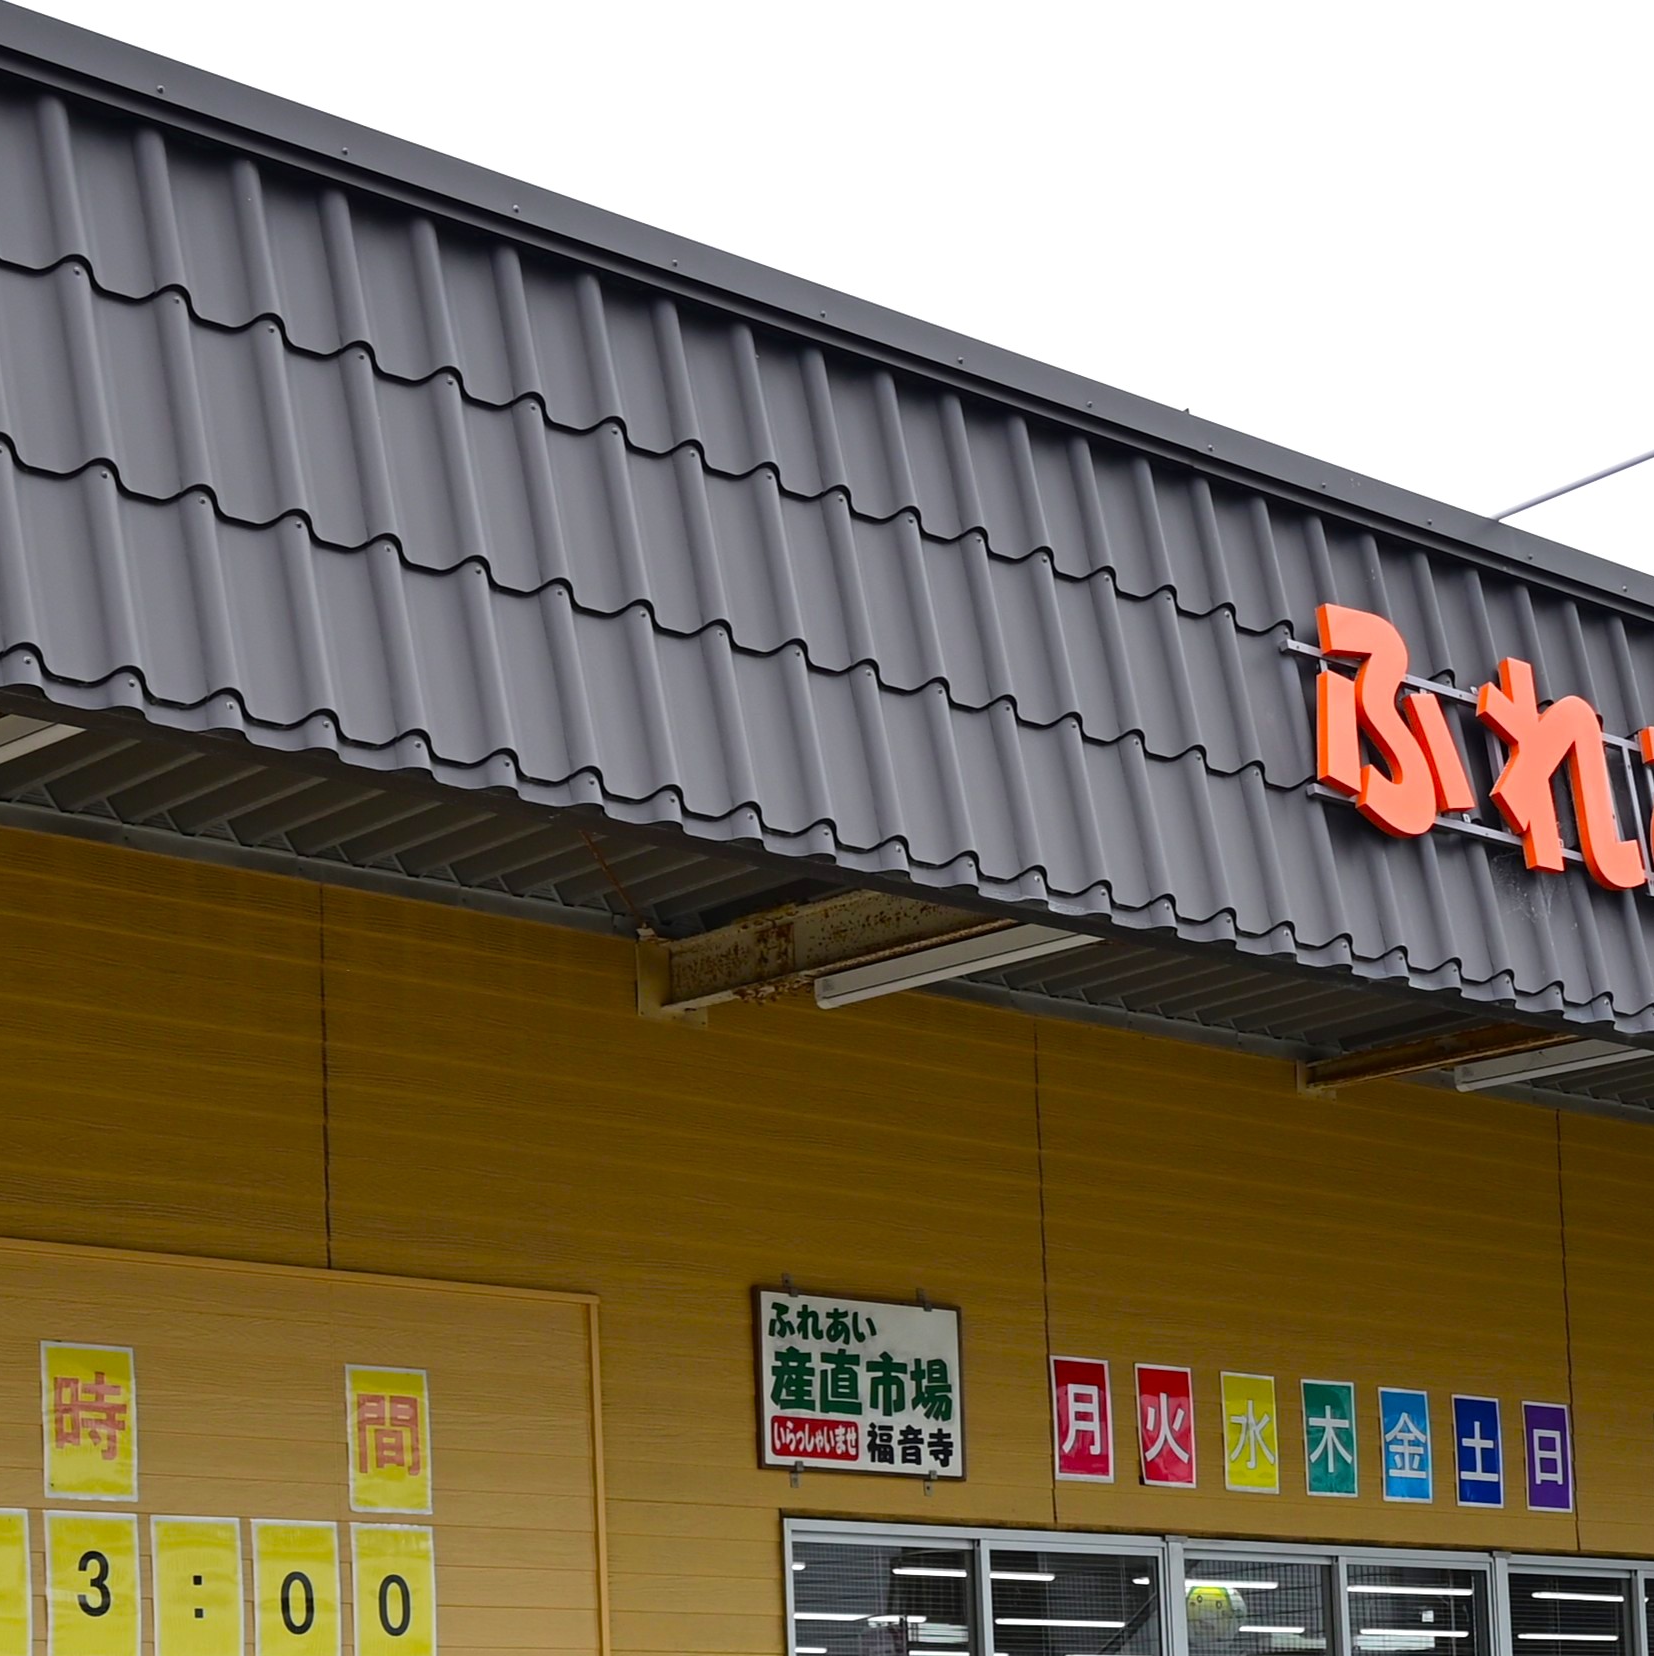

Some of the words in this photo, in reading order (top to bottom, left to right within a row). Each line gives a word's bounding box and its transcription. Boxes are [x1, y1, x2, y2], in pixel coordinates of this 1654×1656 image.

[768, 1302, 877, 1345] ふれあい
[770, 1346, 953, 1421] 産直市場
[773, 1421, 857, 1456] いらっしゃいませ
[867, 1423, 954, 1467] 福音寺
